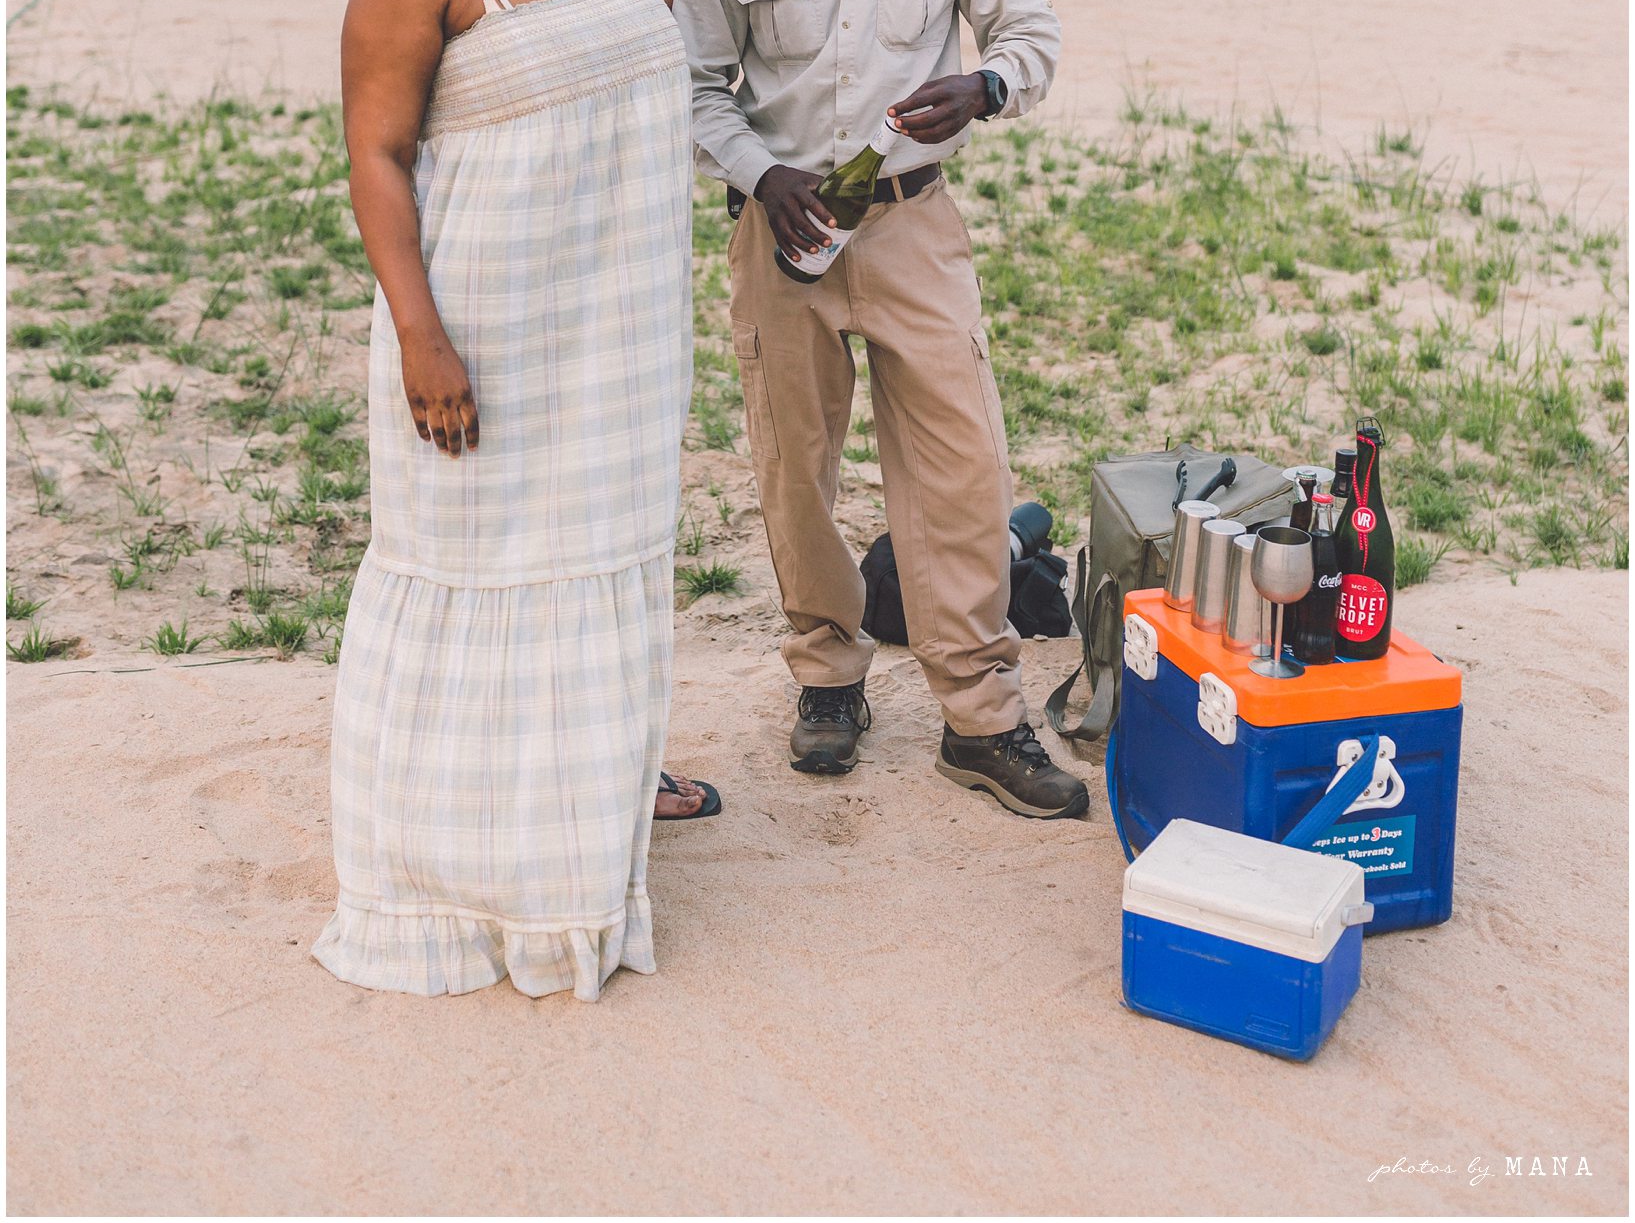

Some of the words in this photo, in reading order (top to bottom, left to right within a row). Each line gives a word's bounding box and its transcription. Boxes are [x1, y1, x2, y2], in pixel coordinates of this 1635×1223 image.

[1357, 511, 1371, 528] VR
[1340, 592, 1385, 611] ELVET
[1339, 607, 1375, 626] ROPE
[1346, 627, 1363, 635] BRUT
[1332, 836, 1346, 844] Ice
[1348, 835, 1359, 843] up
[1361, 833, 1370, 841] to
[1370, 827, 1381, 841] 3
[1381, 830, 1402, 839] Days
[1348, 847, 1394, 859] Warranty
[1390, 861, 1406, 870] Sold
